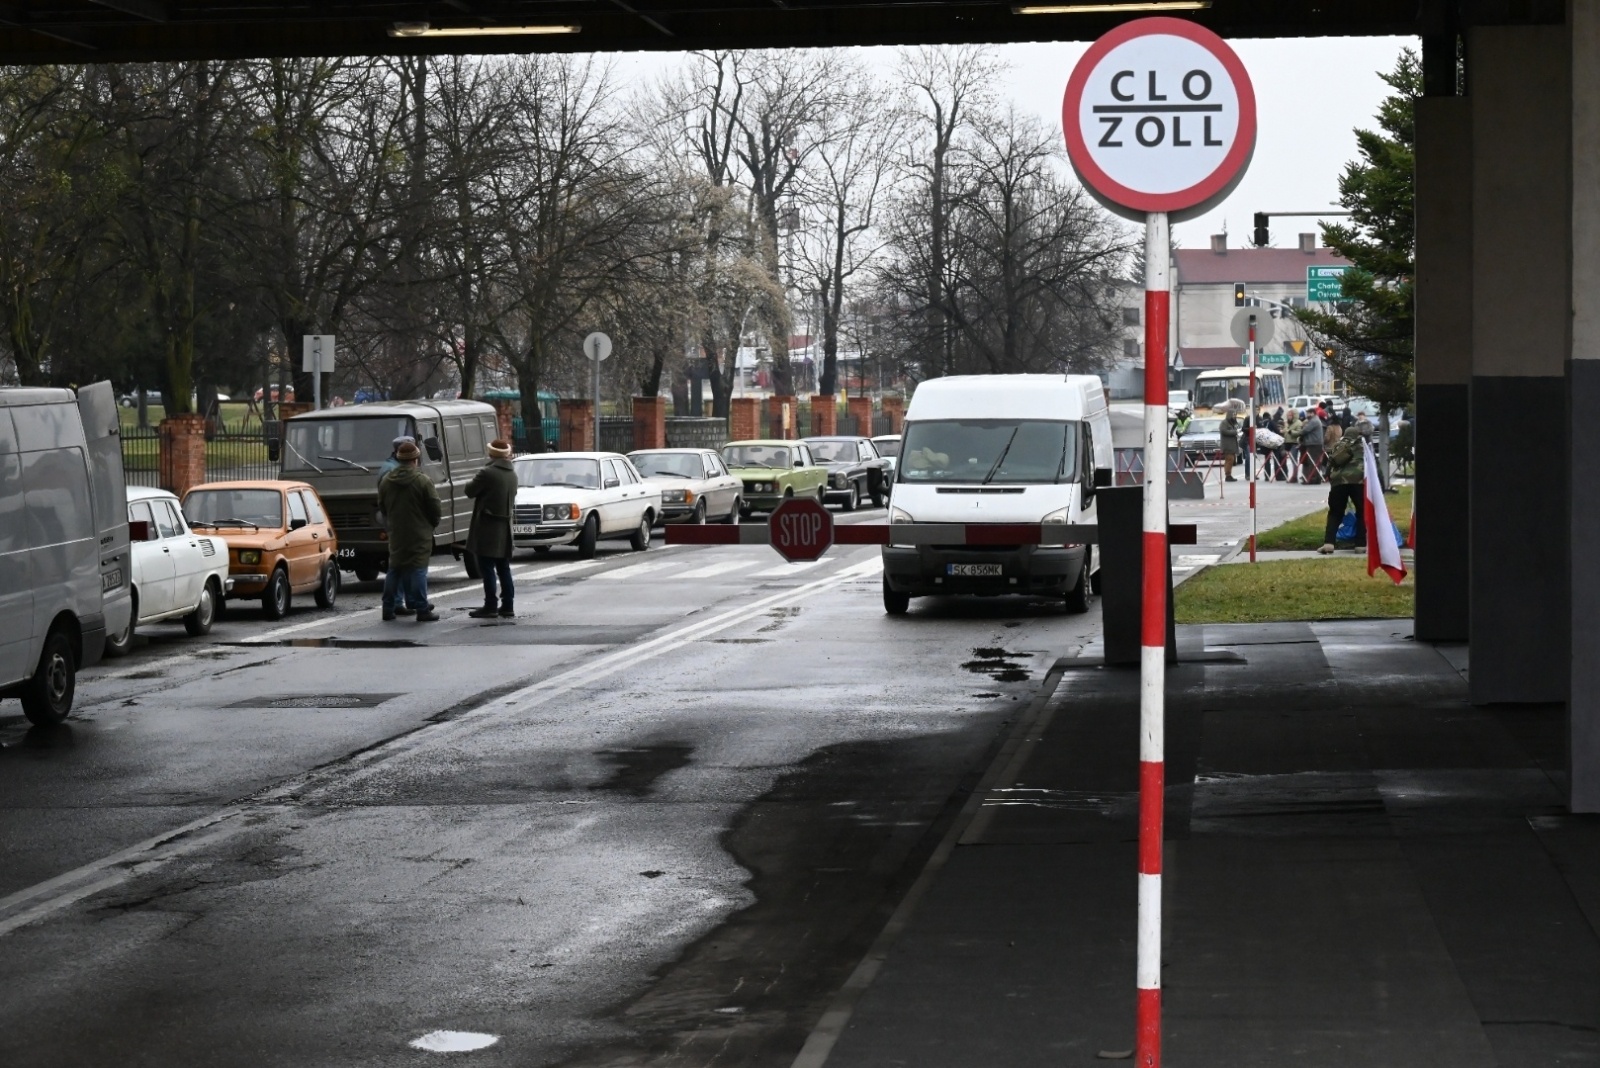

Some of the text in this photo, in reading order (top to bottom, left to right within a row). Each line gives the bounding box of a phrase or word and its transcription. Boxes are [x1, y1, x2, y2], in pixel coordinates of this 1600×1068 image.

[1110, 69, 1212, 102] CLO
[1098, 115, 1223, 147] ZOLL
[1262, 356, 1287, 364] Rybnik
[780, 512, 822, 546] STOP
[953, 565, 968, 576] SK
